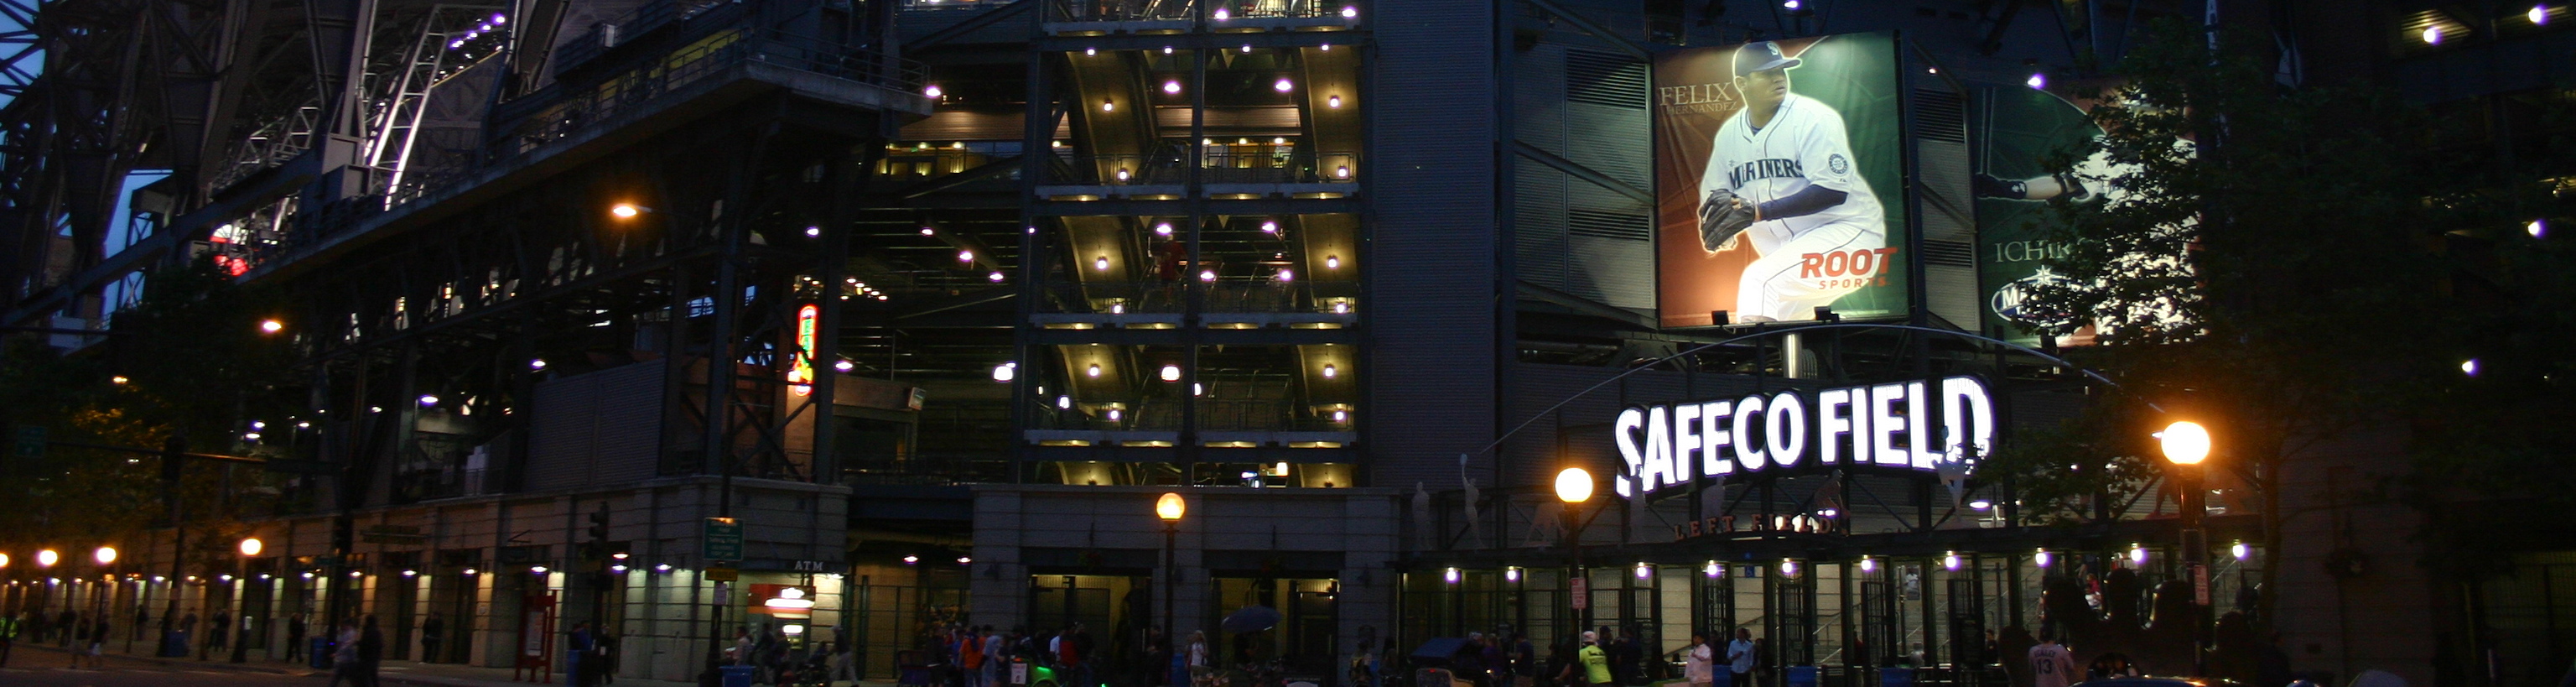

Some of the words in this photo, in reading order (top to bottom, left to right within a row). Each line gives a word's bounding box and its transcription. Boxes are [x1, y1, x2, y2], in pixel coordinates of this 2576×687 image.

[1659, 81, 1733, 107] FELIX
[1728, 158, 1806, 190] MRINERS
[1800, 247, 1898, 278] ROOT
[1819, 276, 1888, 290] SPORTS
[1615, 391, 1805, 499] SAFECO
[1819, 375, 1993, 476] FIELD
[1674, 514, 1736, 541] LEFT
[1752, 513, 1835, 534] FIELD
[794, 560, 823, 571] ATM
[2037, 658, 2053, 674] 13
